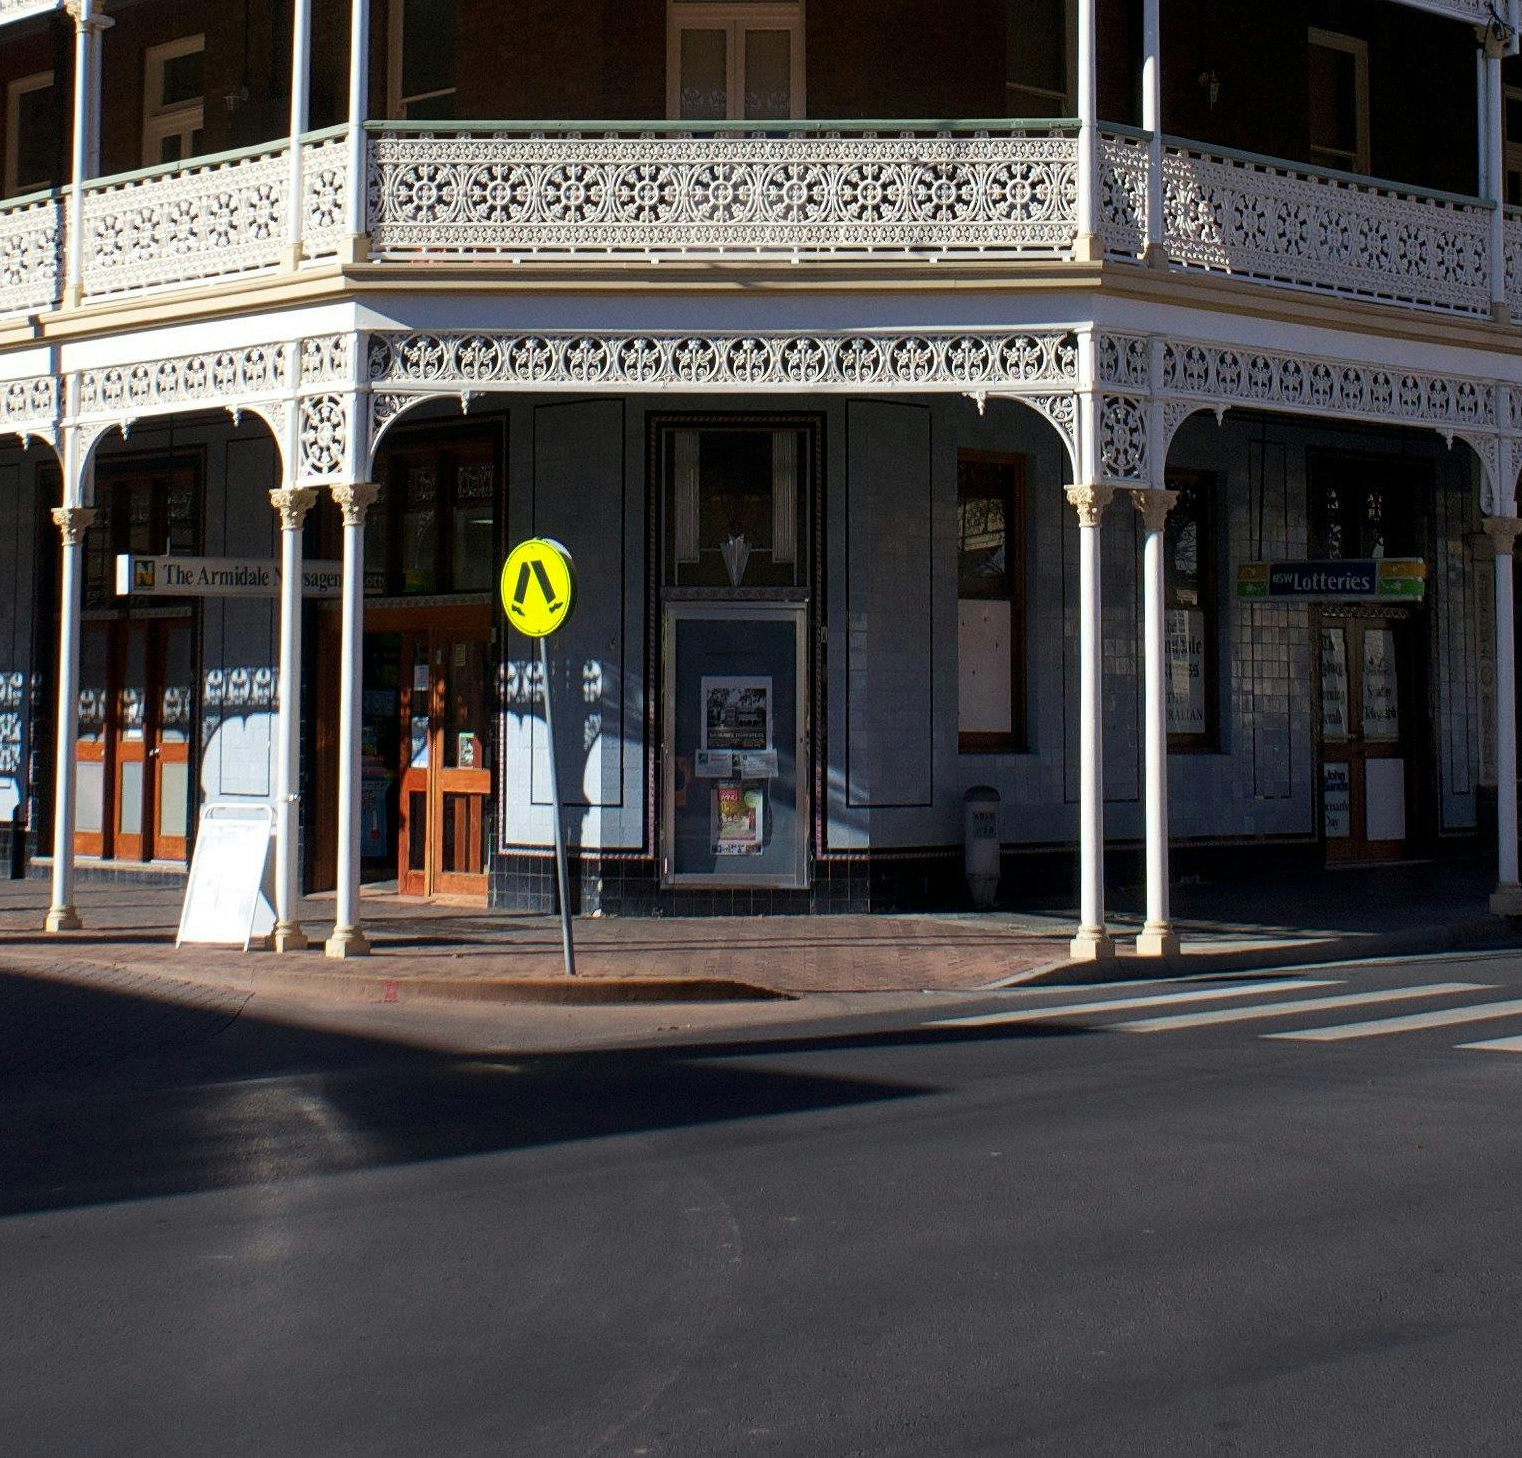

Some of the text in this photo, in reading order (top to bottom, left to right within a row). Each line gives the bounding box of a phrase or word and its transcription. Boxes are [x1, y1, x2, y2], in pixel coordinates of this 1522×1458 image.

[164, 563, 194, 586] The
[197, 566, 270, 587] Armidale
[1272, 572, 1370, 591] NSW Lotteries
